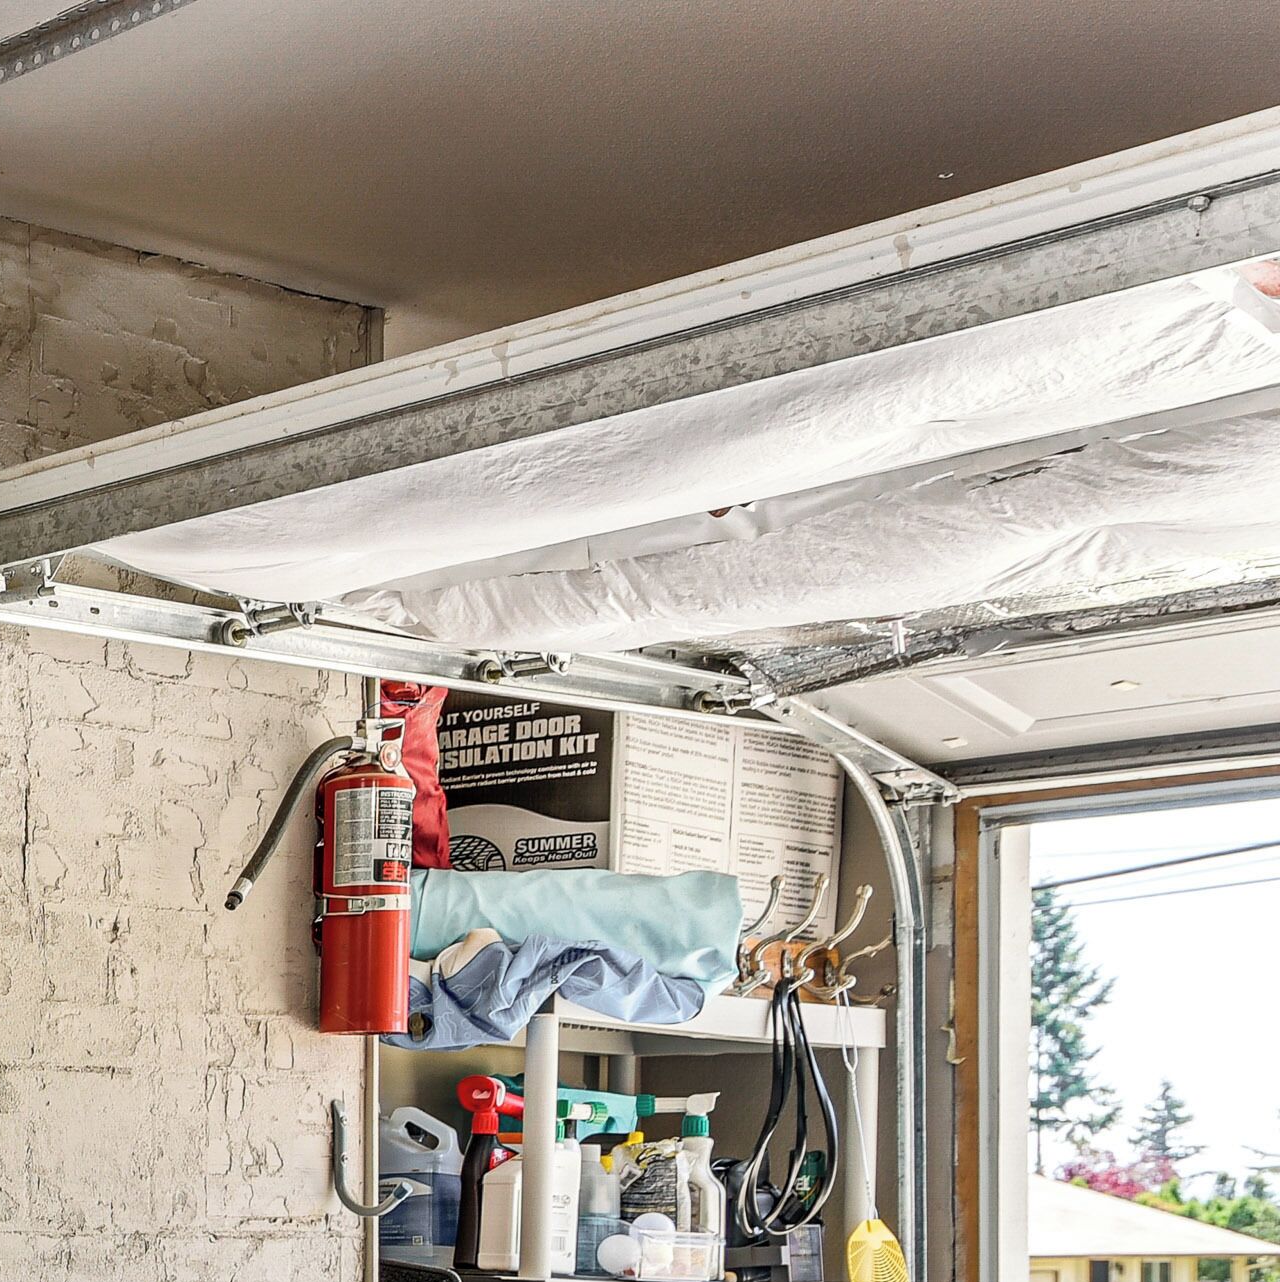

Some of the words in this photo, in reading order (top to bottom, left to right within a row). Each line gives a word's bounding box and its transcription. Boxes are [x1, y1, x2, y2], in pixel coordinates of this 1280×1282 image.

[446, 713, 460, 726] IT
[463, 702, 540, 723] YOURSELF
[440, 724, 510, 749] ARAGE
[516, 714, 582, 741] DOOR
[559, 733, 600, 756] KIT
[450, 781, 476, 790] maximum
[477, 779, 497, 787] radiant
[517, 774, 547, 783] protection
[462, 774, 485, 782] Barrier's
[485, 771, 505, 779] proven
[506, 768, 537, 776] technology
[537, 765, 566, 773] combines
[516, 834, 595, 854] SUMMER
[515, 852, 545, 864] Keeps
[547, 852, 572, 862] Heat
[574, 850, 597, 859] Out!
